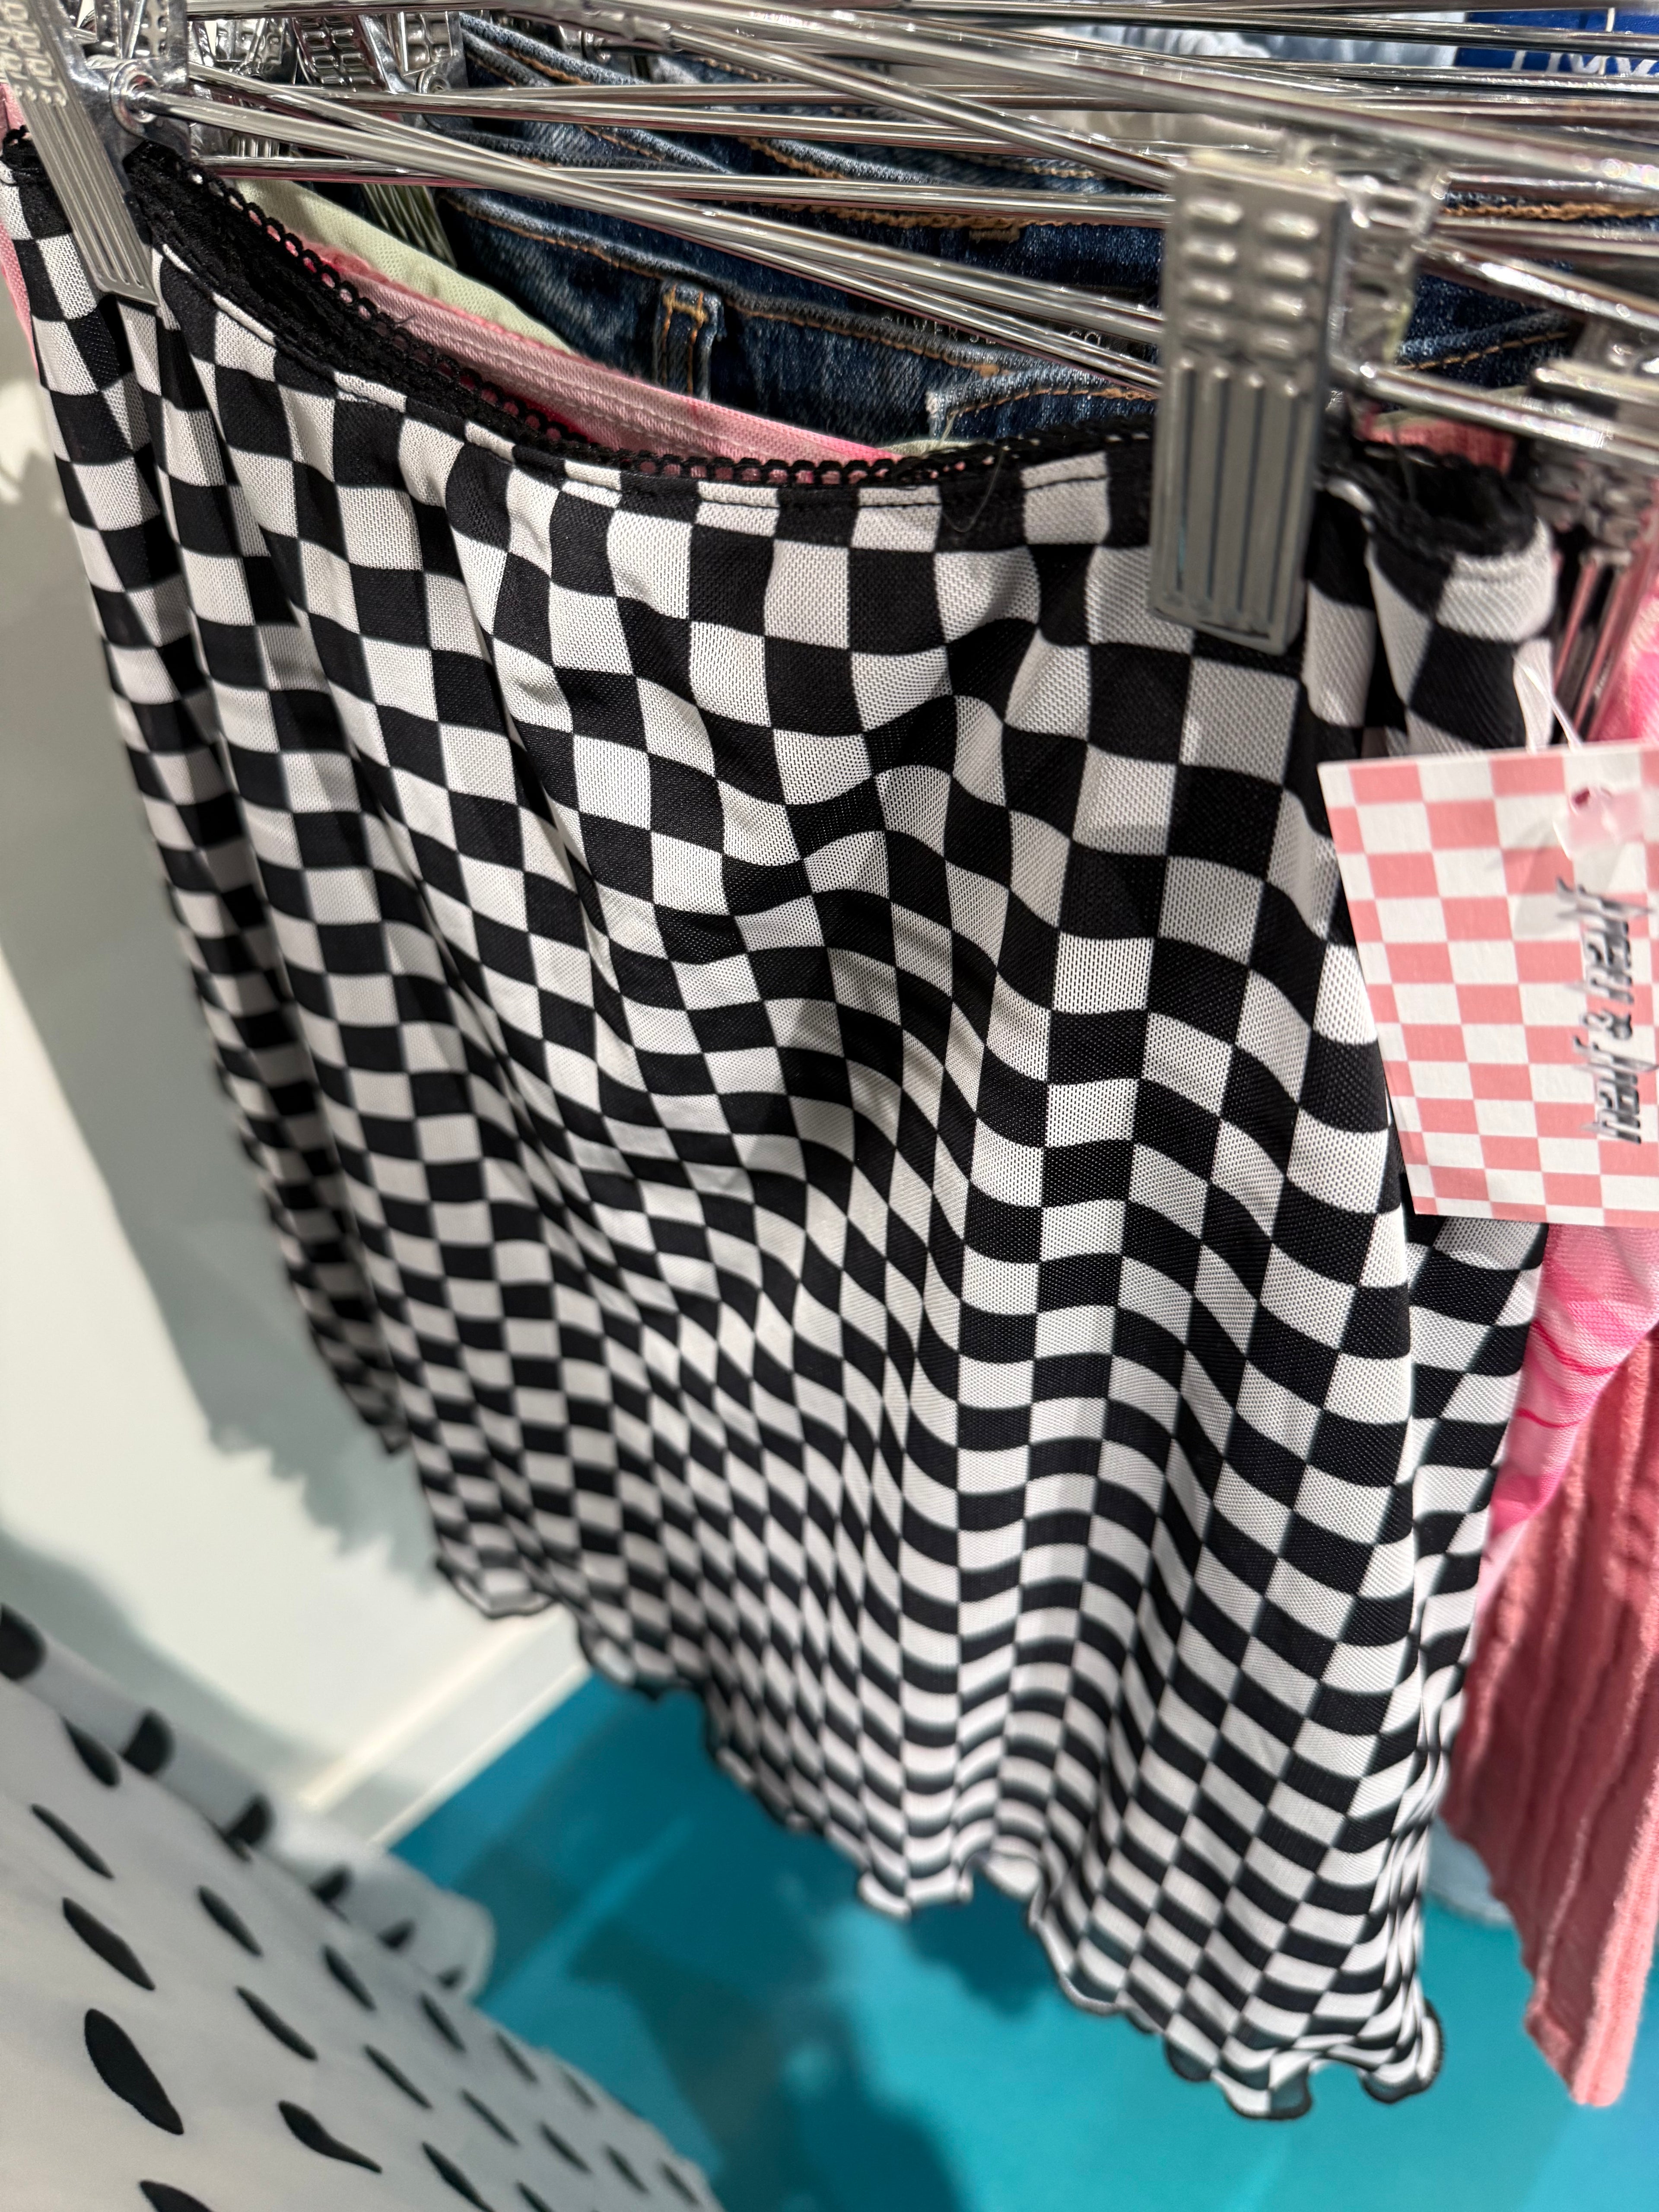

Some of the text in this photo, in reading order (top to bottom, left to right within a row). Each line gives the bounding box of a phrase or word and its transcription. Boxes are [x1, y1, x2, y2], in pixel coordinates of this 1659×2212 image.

[1556, 876, 1659, 1145] half & half
